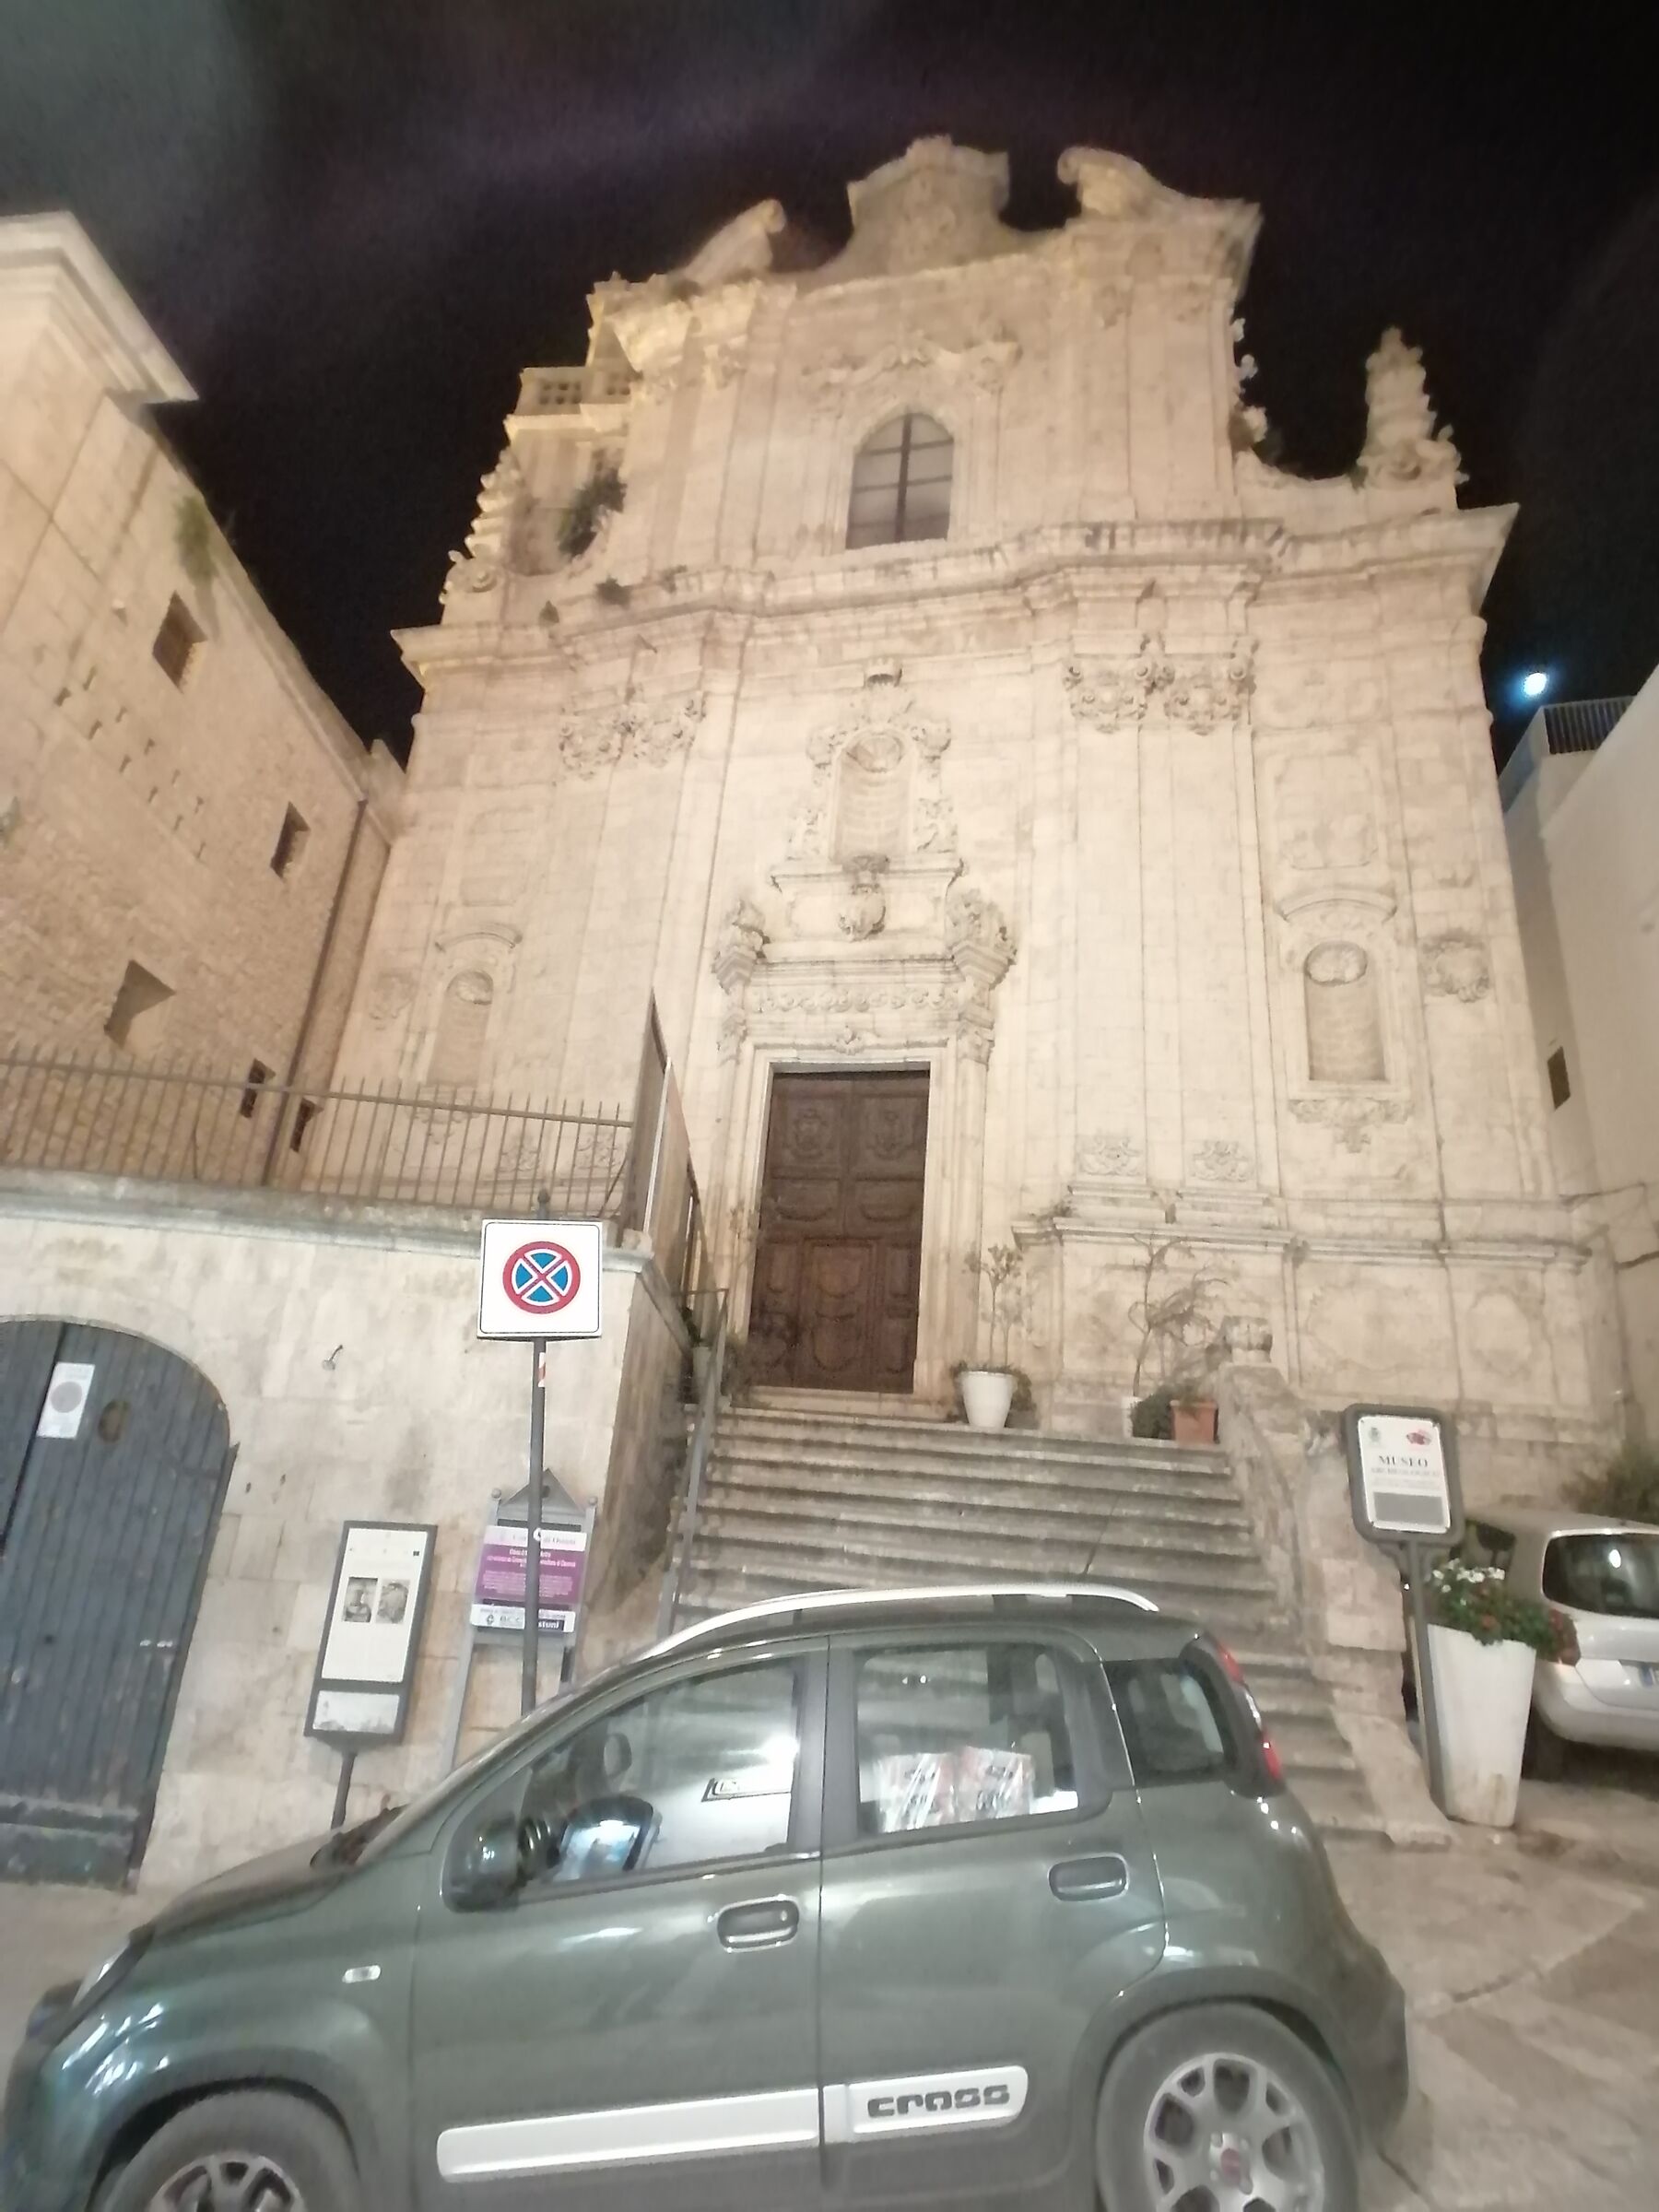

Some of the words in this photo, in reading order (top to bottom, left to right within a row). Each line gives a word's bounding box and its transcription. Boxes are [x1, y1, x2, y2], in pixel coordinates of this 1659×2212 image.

[1378, 1454, 1429, 1467] MUSEO
[538, 1620, 559, 1629] stuni
[867, 2084, 1010, 2118] cross
